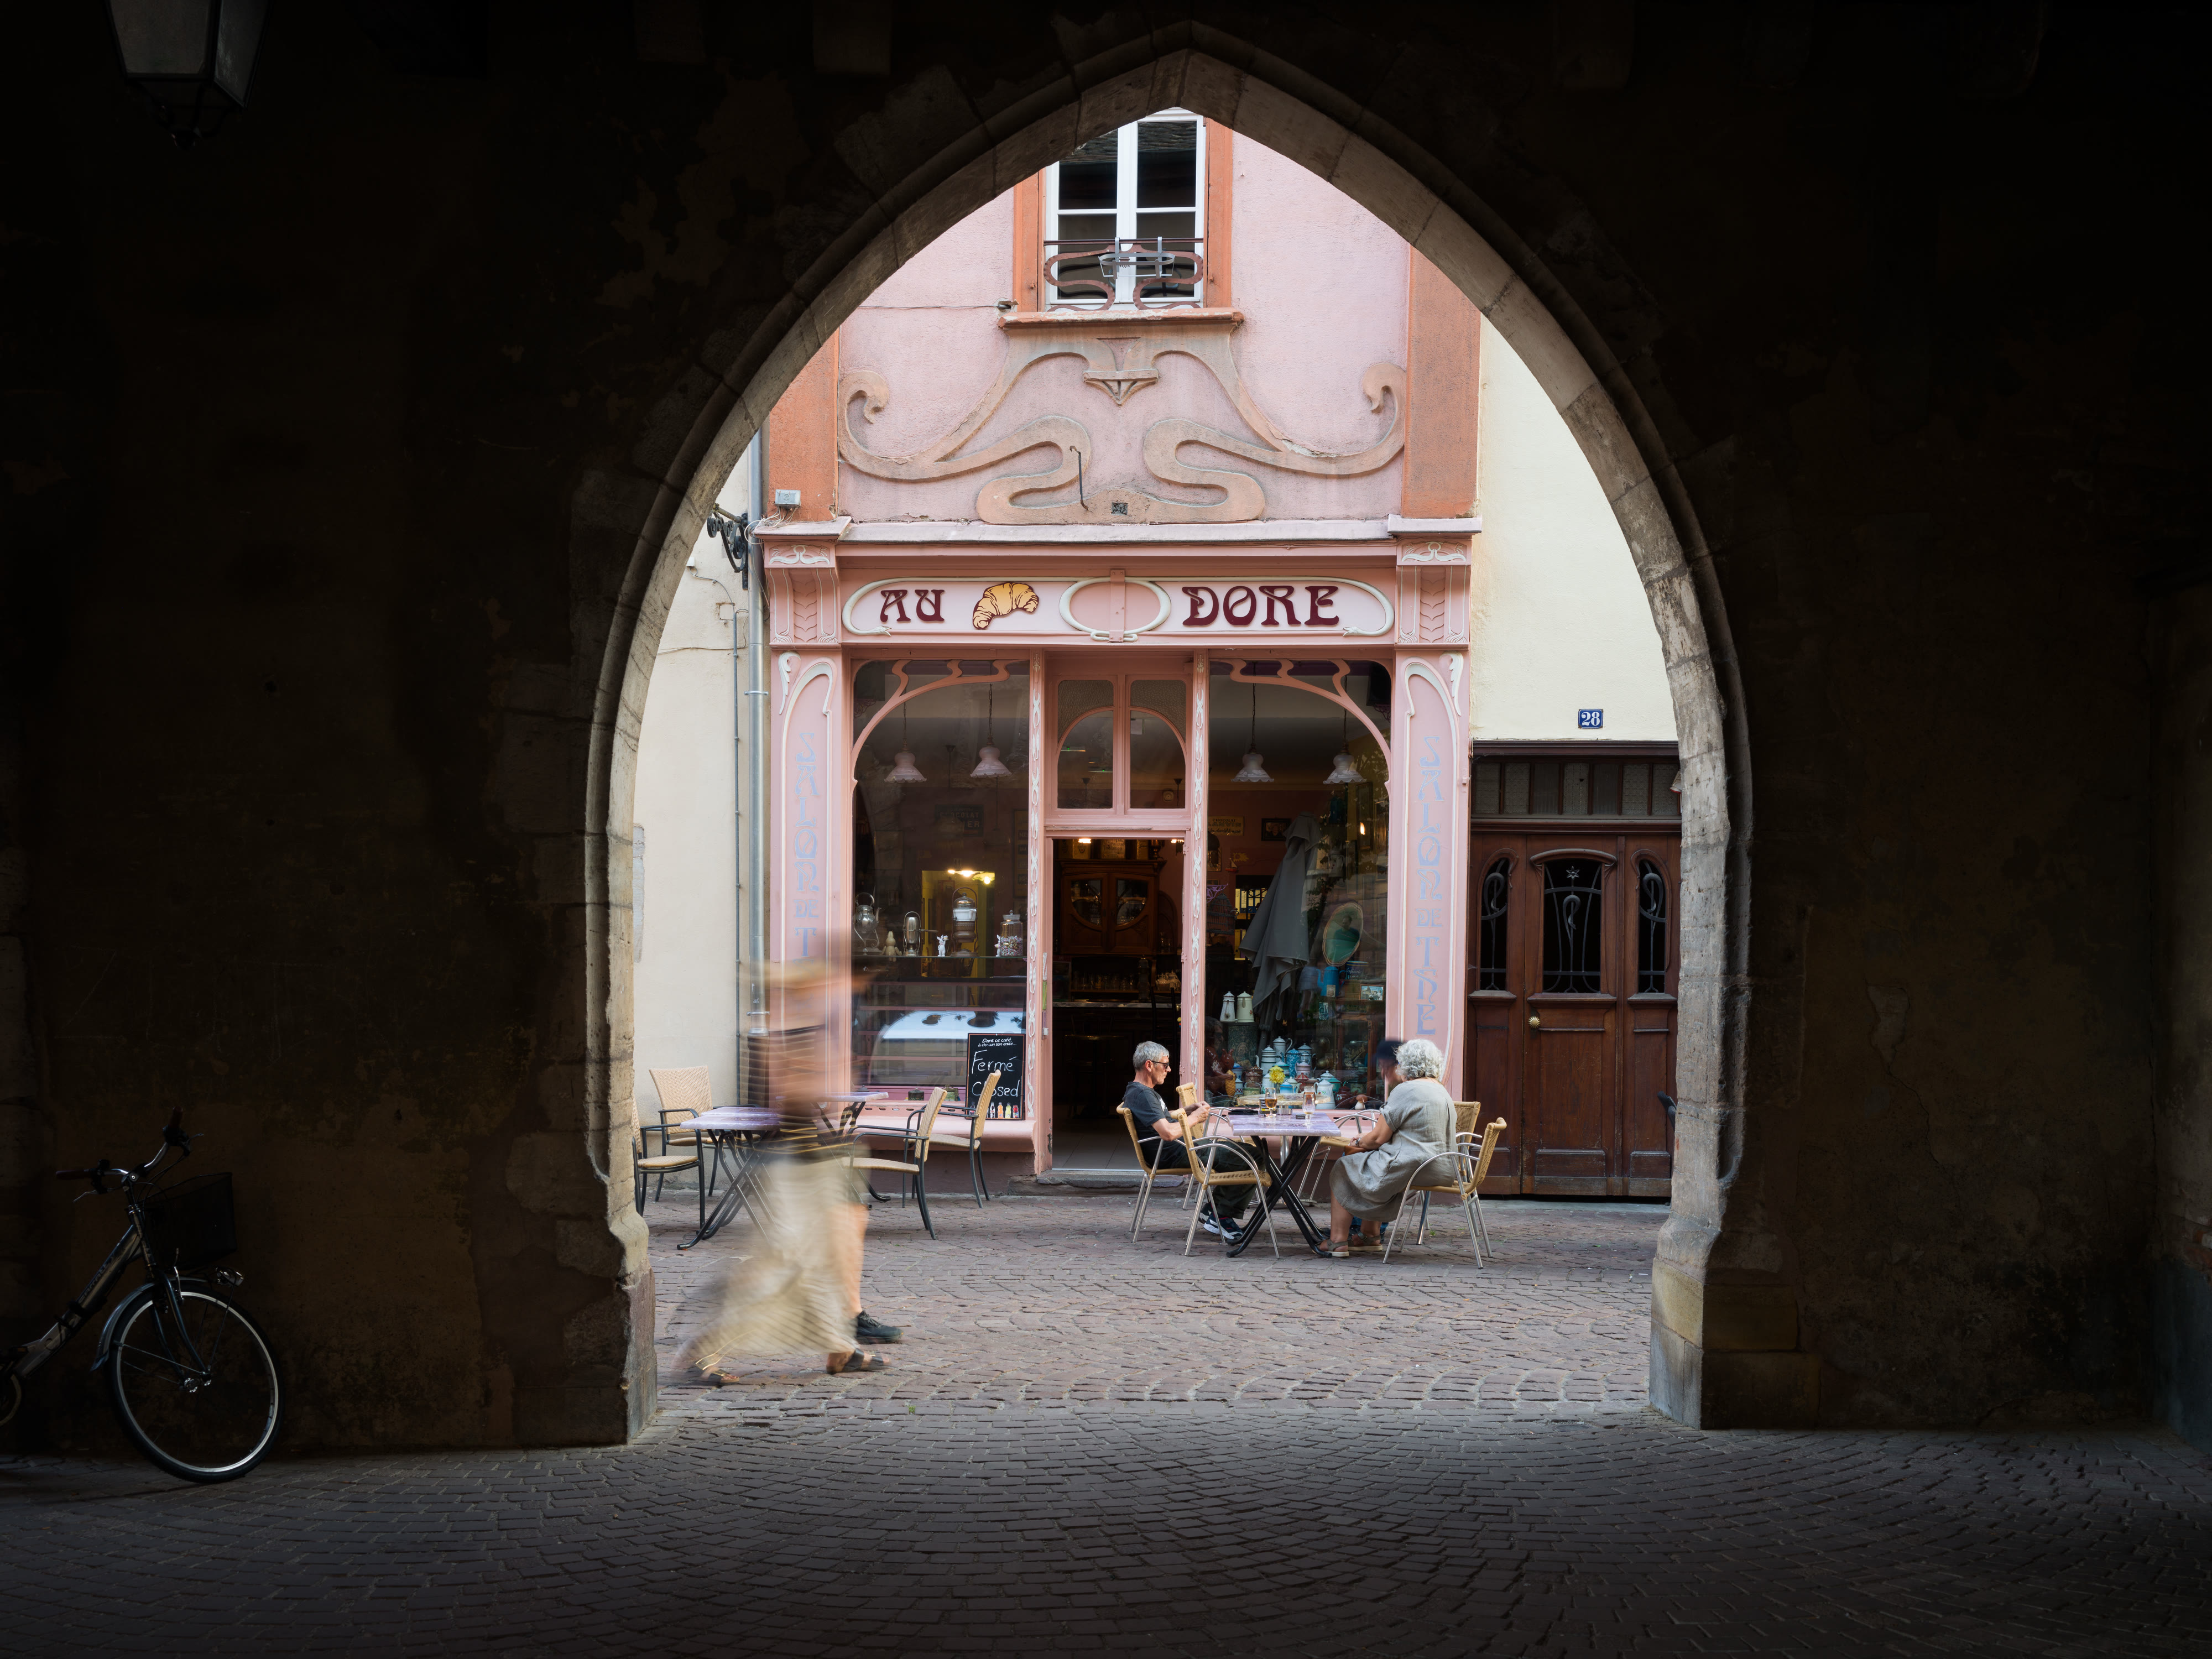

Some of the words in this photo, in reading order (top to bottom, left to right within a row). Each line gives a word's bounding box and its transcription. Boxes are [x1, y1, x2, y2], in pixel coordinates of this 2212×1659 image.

[880, 589, 945, 623] AU
[1182, 585, 1340, 627] DORE
[1581, 711, 1600, 726] 28
[794, 732, 820, 892] SALON
[1416, 736, 1444, 900] SALON
[793, 899, 820, 919] DE
[1415, 907, 1443, 928] DE
[1413, 936, 1439, 1036] THE
[972, 1050, 1017, 1074] Fermé
[972, 1079, 1020, 1098] Cosed
